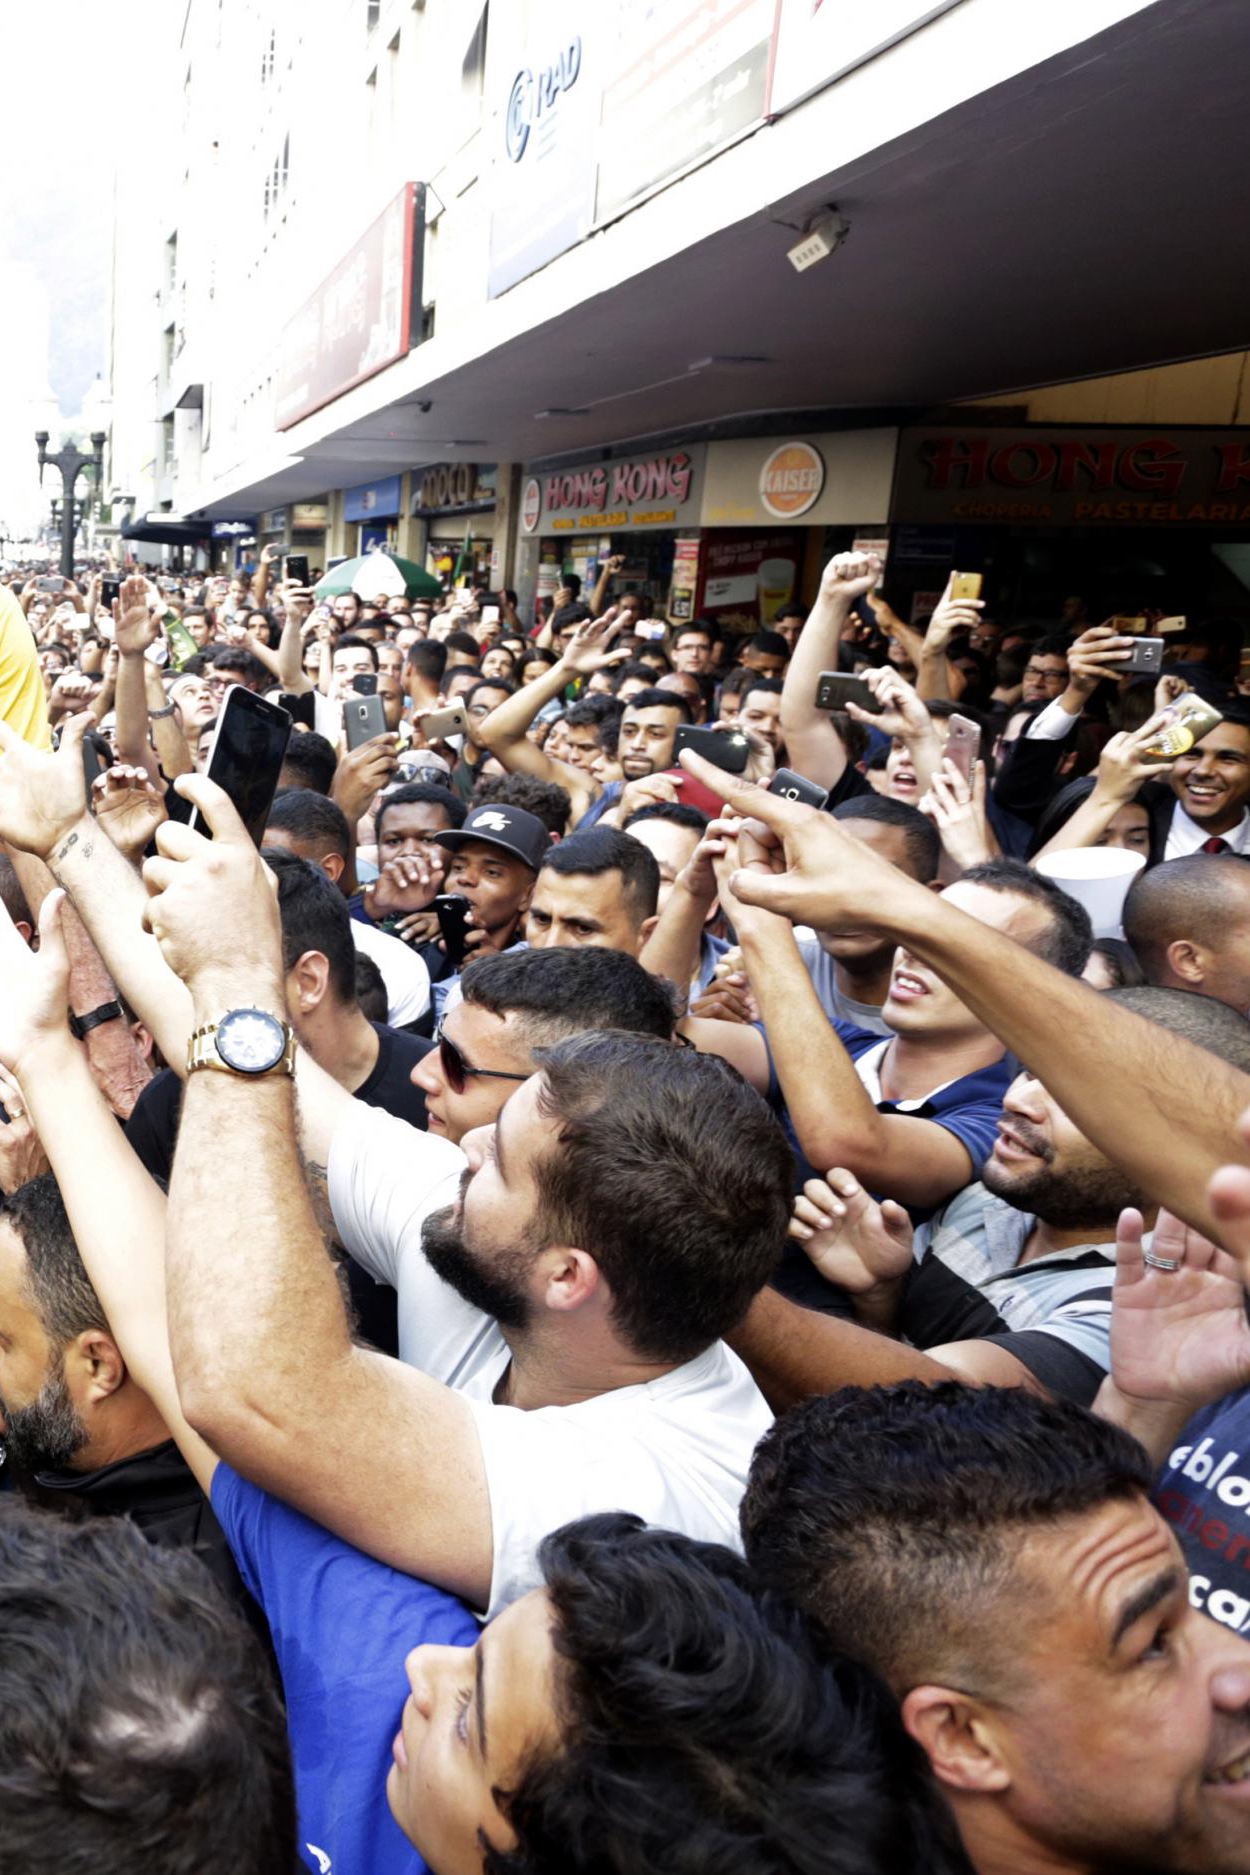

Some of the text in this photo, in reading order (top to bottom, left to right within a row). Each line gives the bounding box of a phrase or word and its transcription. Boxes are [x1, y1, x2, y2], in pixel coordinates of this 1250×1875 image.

[545, 453, 693, 512] HONG KONG
[763, 466, 824, 493] KAISER
[928, 437, 1188, 497] HONG
[953, 502, 1054, 519] CHOPERIA
